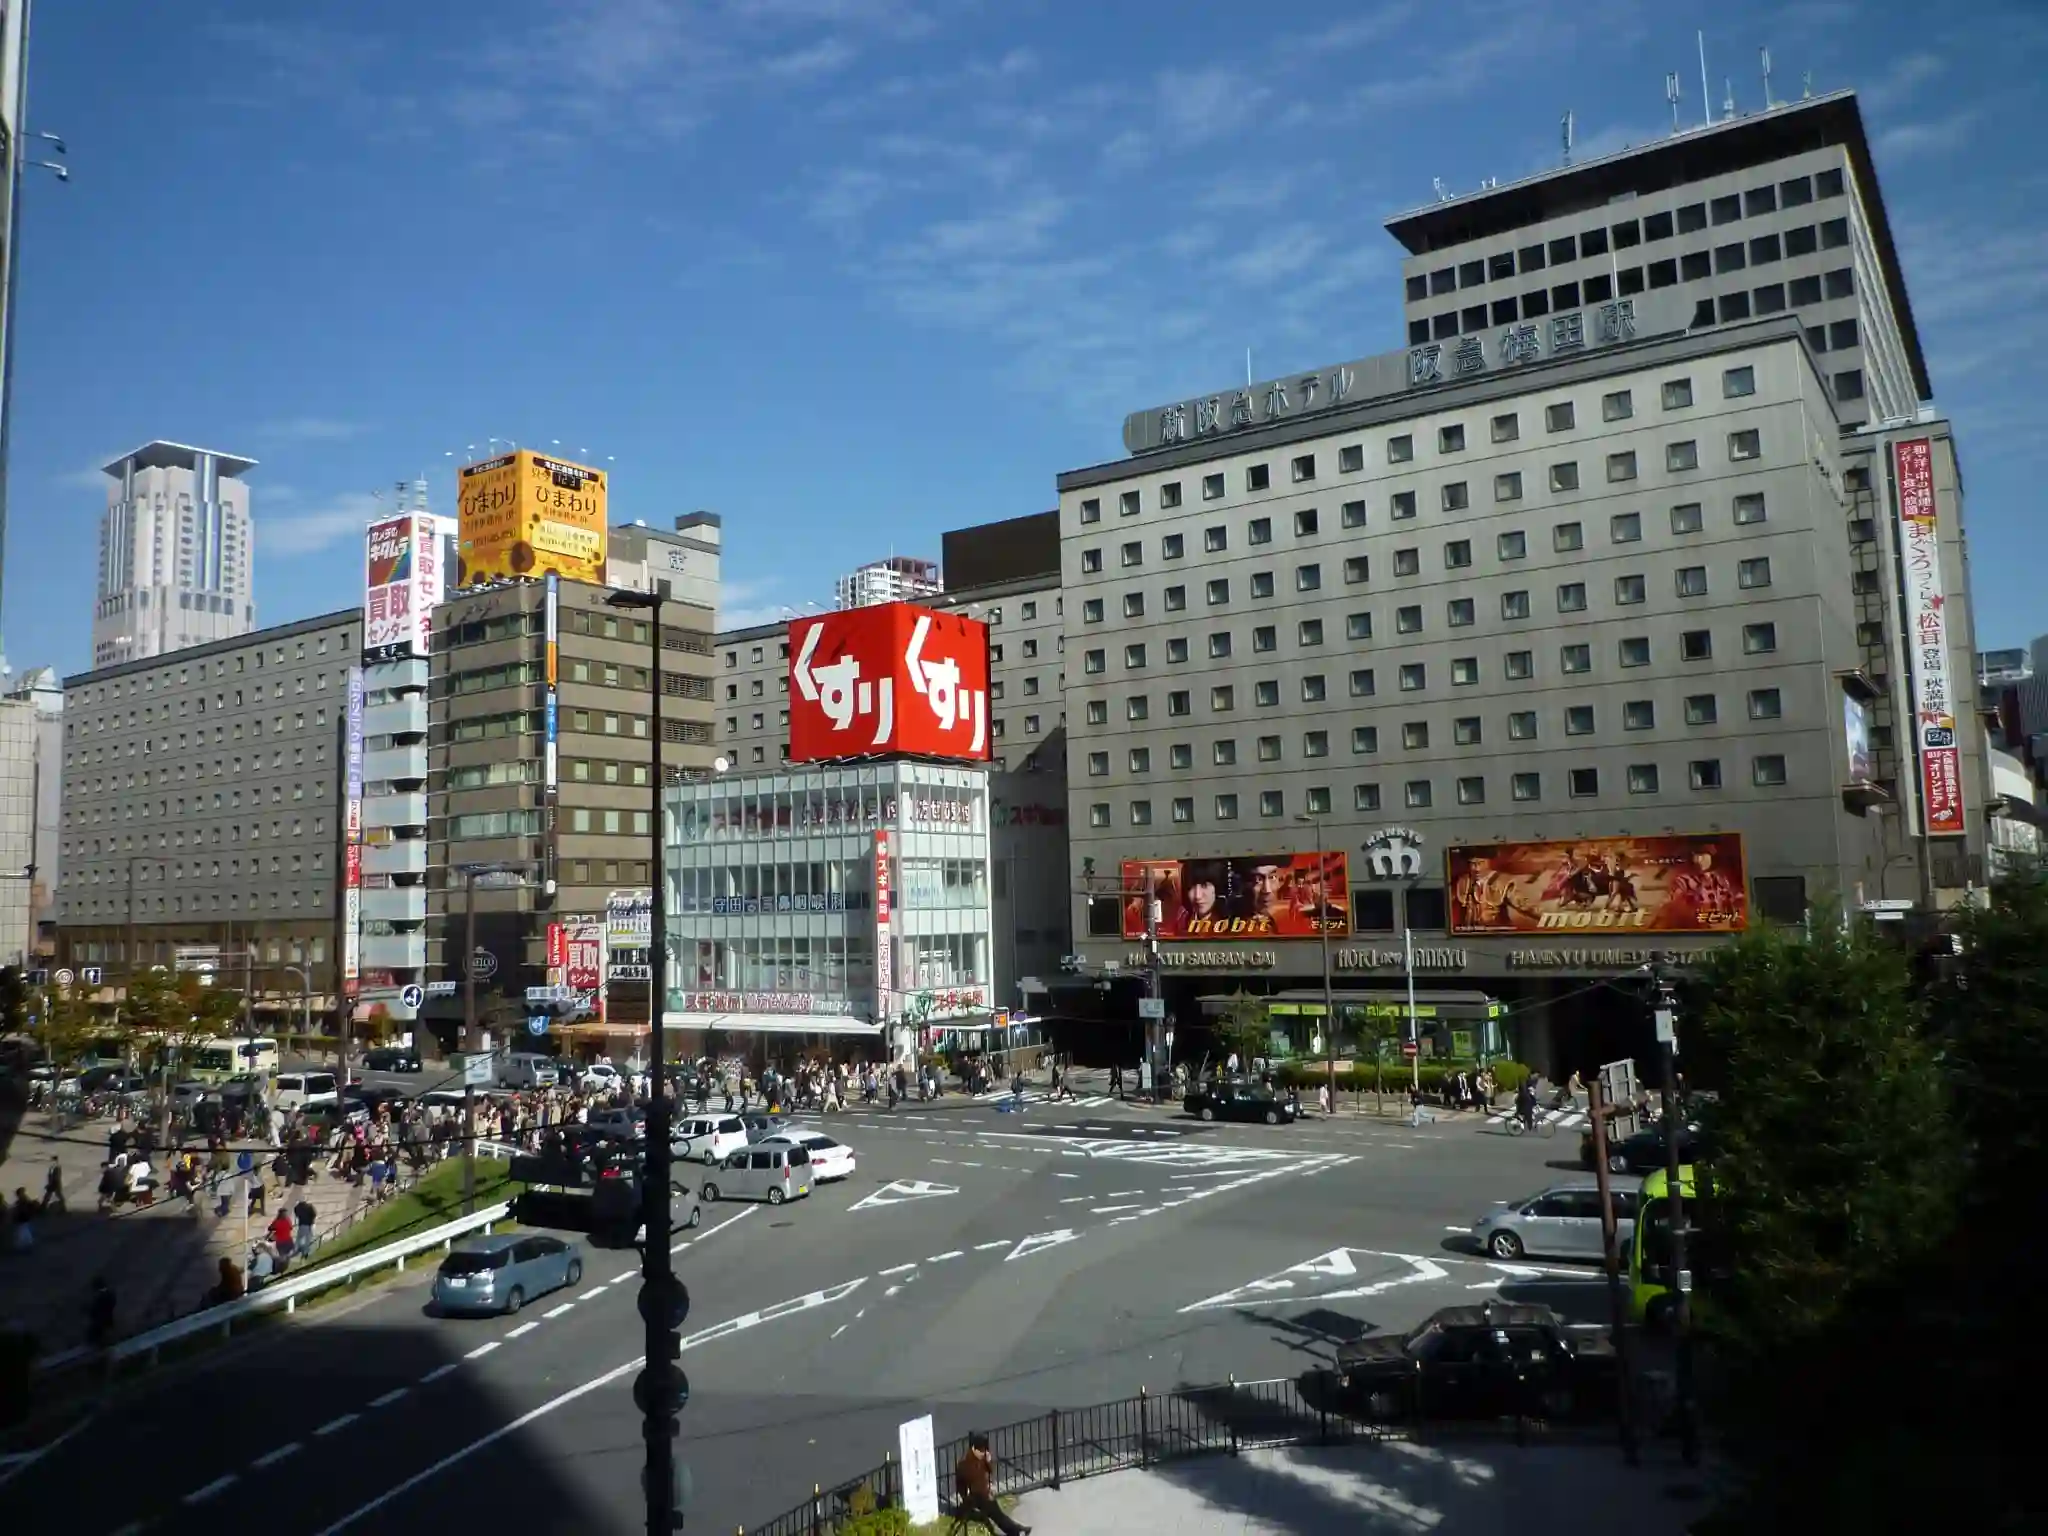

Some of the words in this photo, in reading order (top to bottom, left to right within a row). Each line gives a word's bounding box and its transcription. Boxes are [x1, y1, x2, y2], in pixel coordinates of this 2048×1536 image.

[1410, 300, 1638, 384] 阪急梅田駅
[1161, 366, 1354, 441] 新阪急ホテル
[464, 482, 517, 516] ひまわり
[536, 485, 597, 516] ひまわり
[370, 536, 409, 561] キタムラ
[369, 585, 410, 623] 買取
[368, 622, 410, 645] センター
[794, 623, 893, 745] くすり
[905, 616, 984, 752] くすり
[1188, 915, 1272, 933] mobit
[1537, 908, 1650, 928] mobit
[1696, 909, 1743, 923] モビット
[568, 943, 598, 972] 買取
[1128, 951, 1185, 965] HAKYU
[1592, 949, 1661, 965] UMED
[571, 973, 596, 984] センター
